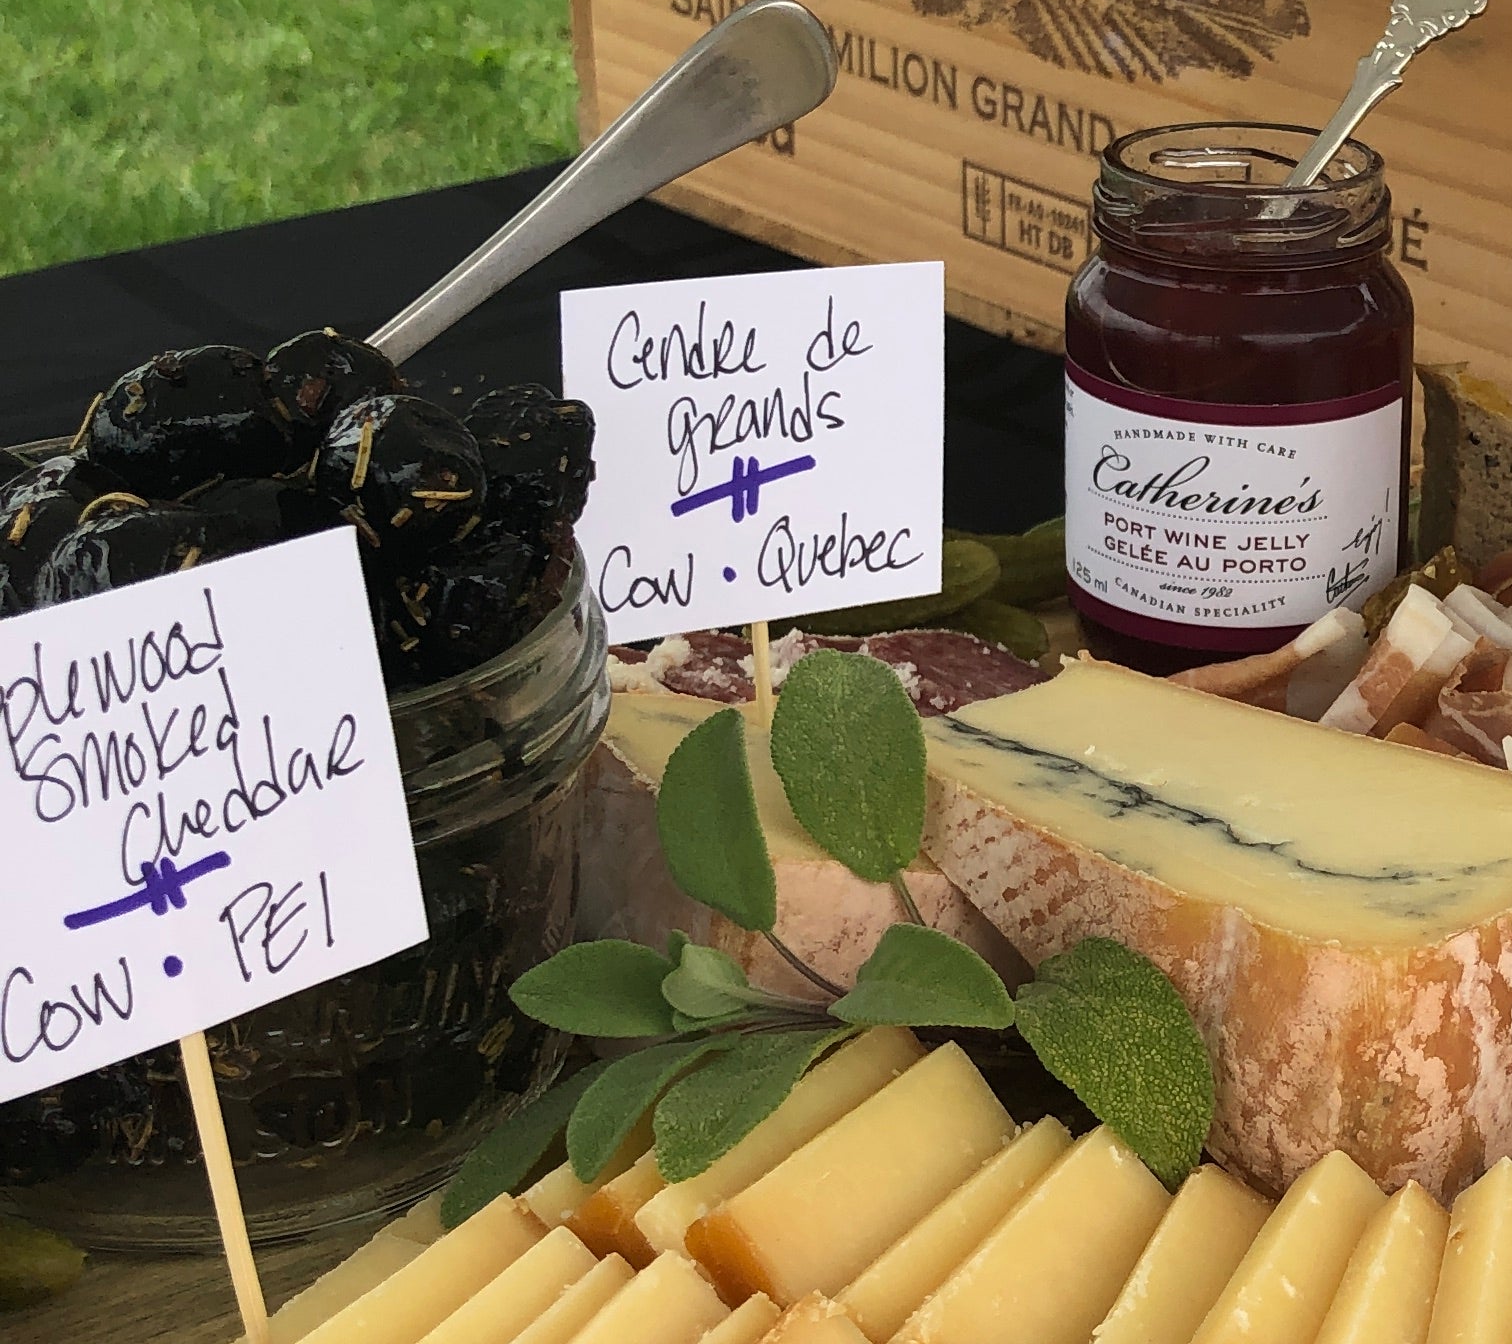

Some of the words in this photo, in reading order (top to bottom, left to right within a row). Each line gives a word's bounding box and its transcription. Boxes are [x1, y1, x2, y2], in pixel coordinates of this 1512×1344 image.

[828, 24, 958, 109] MILION
[971, 74, 1115, 157] GRAND
[806, 295, 874, 371] de
[1113, 428, 1197, 443] HANDMADE
[1204, 433, 1248, 449] WITH
[1257, 442, 1297, 459] CARE
[1092, 444, 1324, 515] Catherine's
[599, 545, 693, 614] Cow
[757, 512, 924, 593] Quebec
[1104, 512, 1157, 540] PORT
[1164, 528, 1227, 550] WINE
[1237, 533, 1311, 552] JELLY
[1104, 535, 1169, 566] GELÉE
[1177, 556, 1210, 572] AU
[1222, 557, 1307, 574] PORTO
[1114, 576, 1186, 615] CANADIAN
[1194, 595, 1288, 619] SPECIALITY
[1159, 581, 1198, 596] since
[0, 587, 225, 775] plewood
[1, 956, 134, 1062] Cow
[220, 871, 335, 982] PEI
